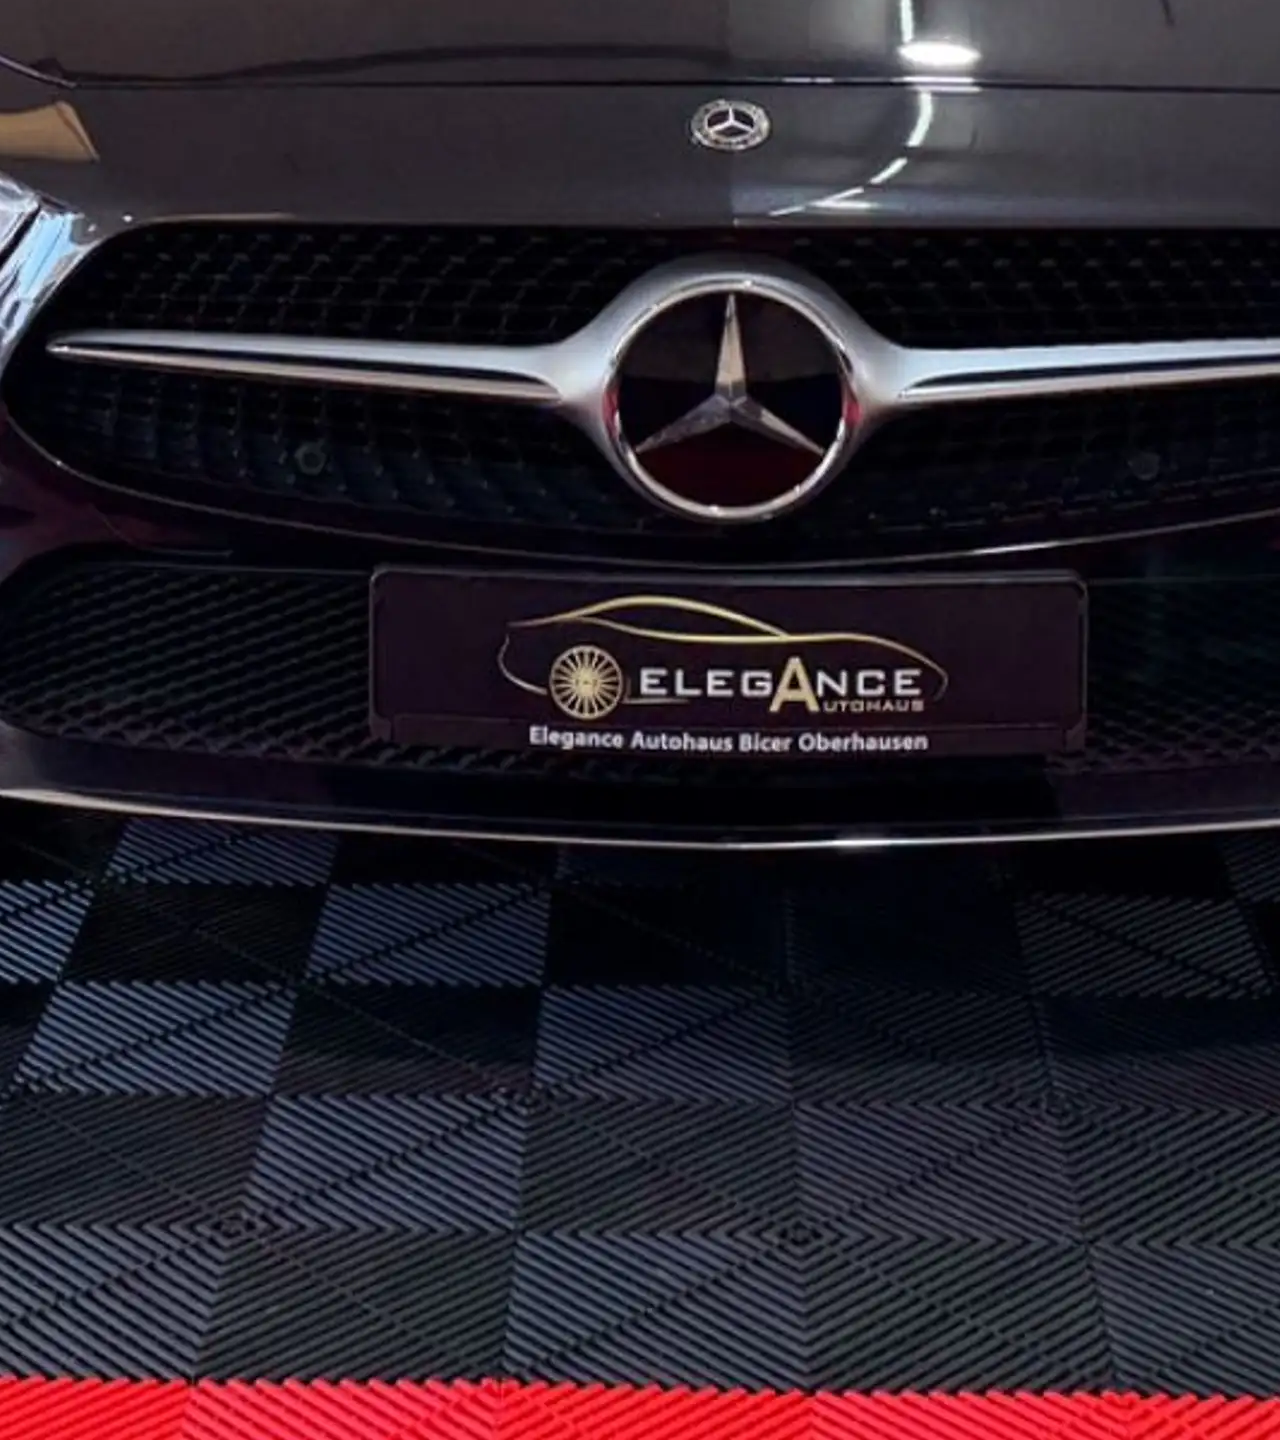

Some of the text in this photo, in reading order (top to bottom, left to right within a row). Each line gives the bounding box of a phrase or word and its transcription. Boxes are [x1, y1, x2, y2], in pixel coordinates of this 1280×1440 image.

[639, 656, 922, 712] ELEGANCE
[529, 725, 929, 752] Elegance Autohaus Bicer Oberhausen
